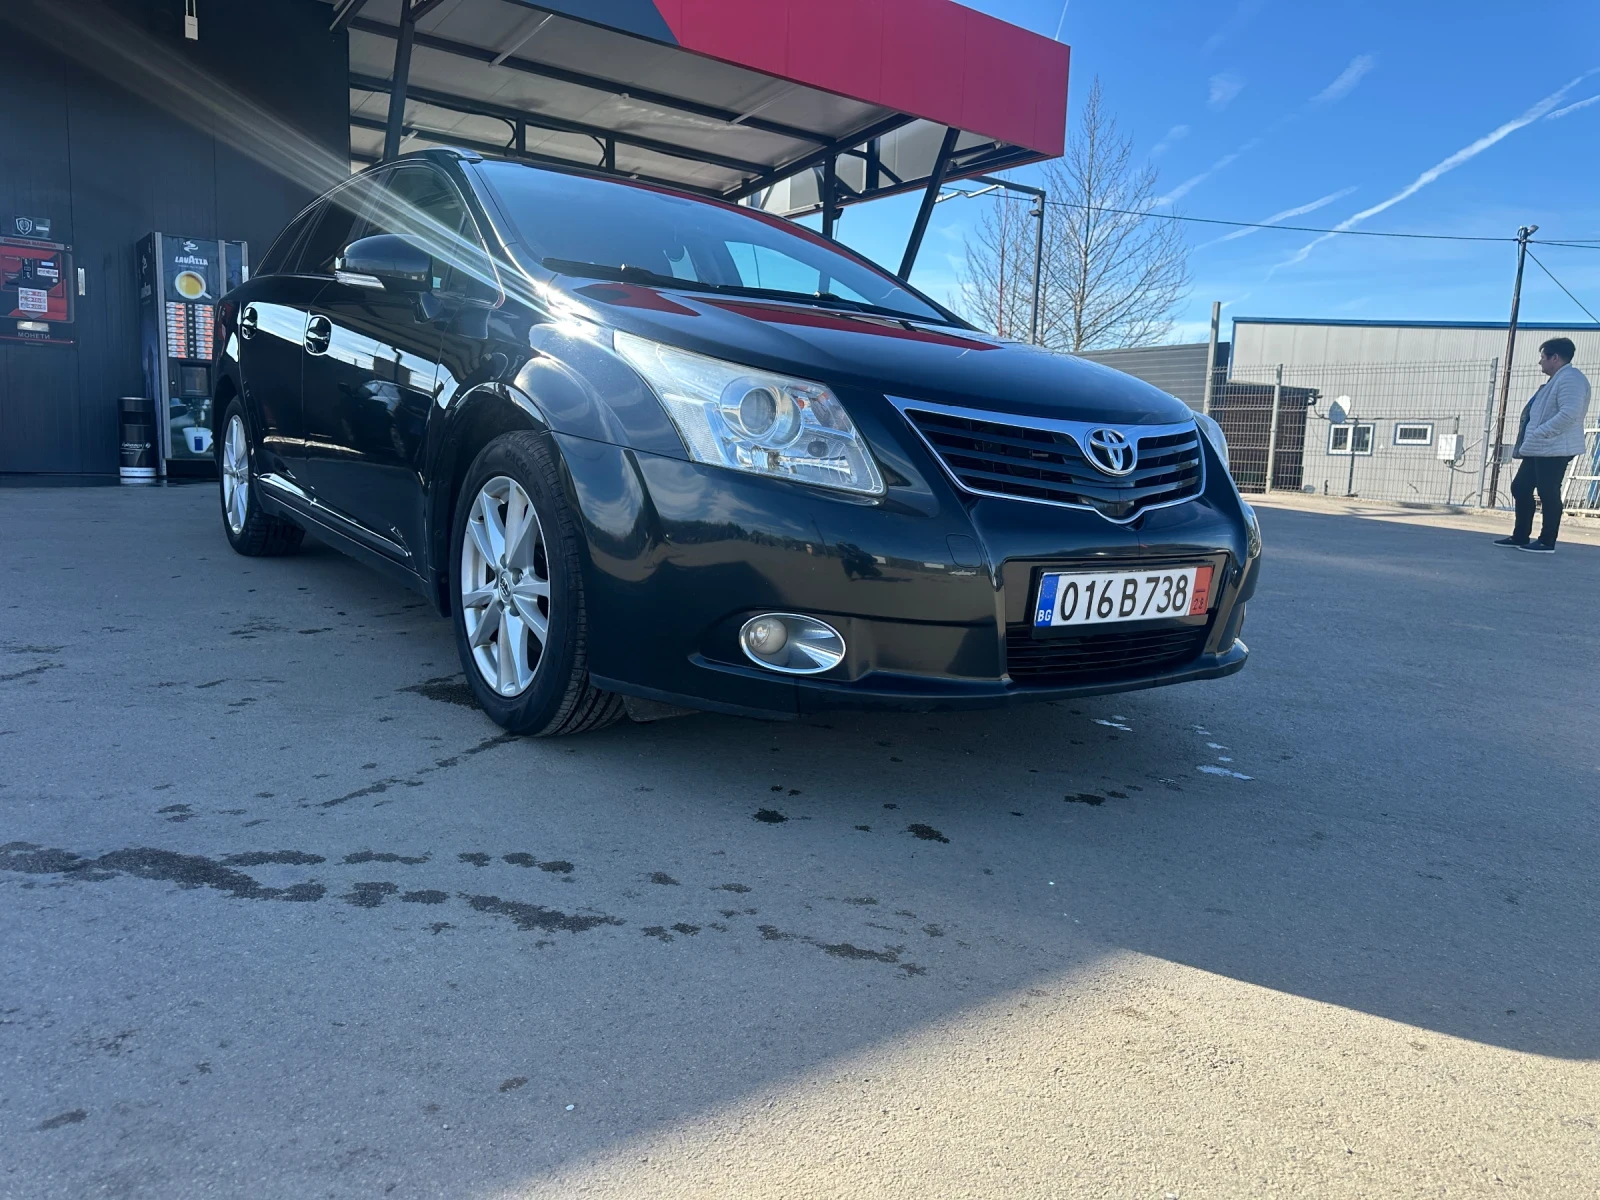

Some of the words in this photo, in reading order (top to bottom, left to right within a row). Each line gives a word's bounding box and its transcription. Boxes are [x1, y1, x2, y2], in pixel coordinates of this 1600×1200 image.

[174, 255, 209, 266] LAVAZZA
[17, 331, 51, 340] МОНЕТИ
[1037, 609, 1052, 622] BG
